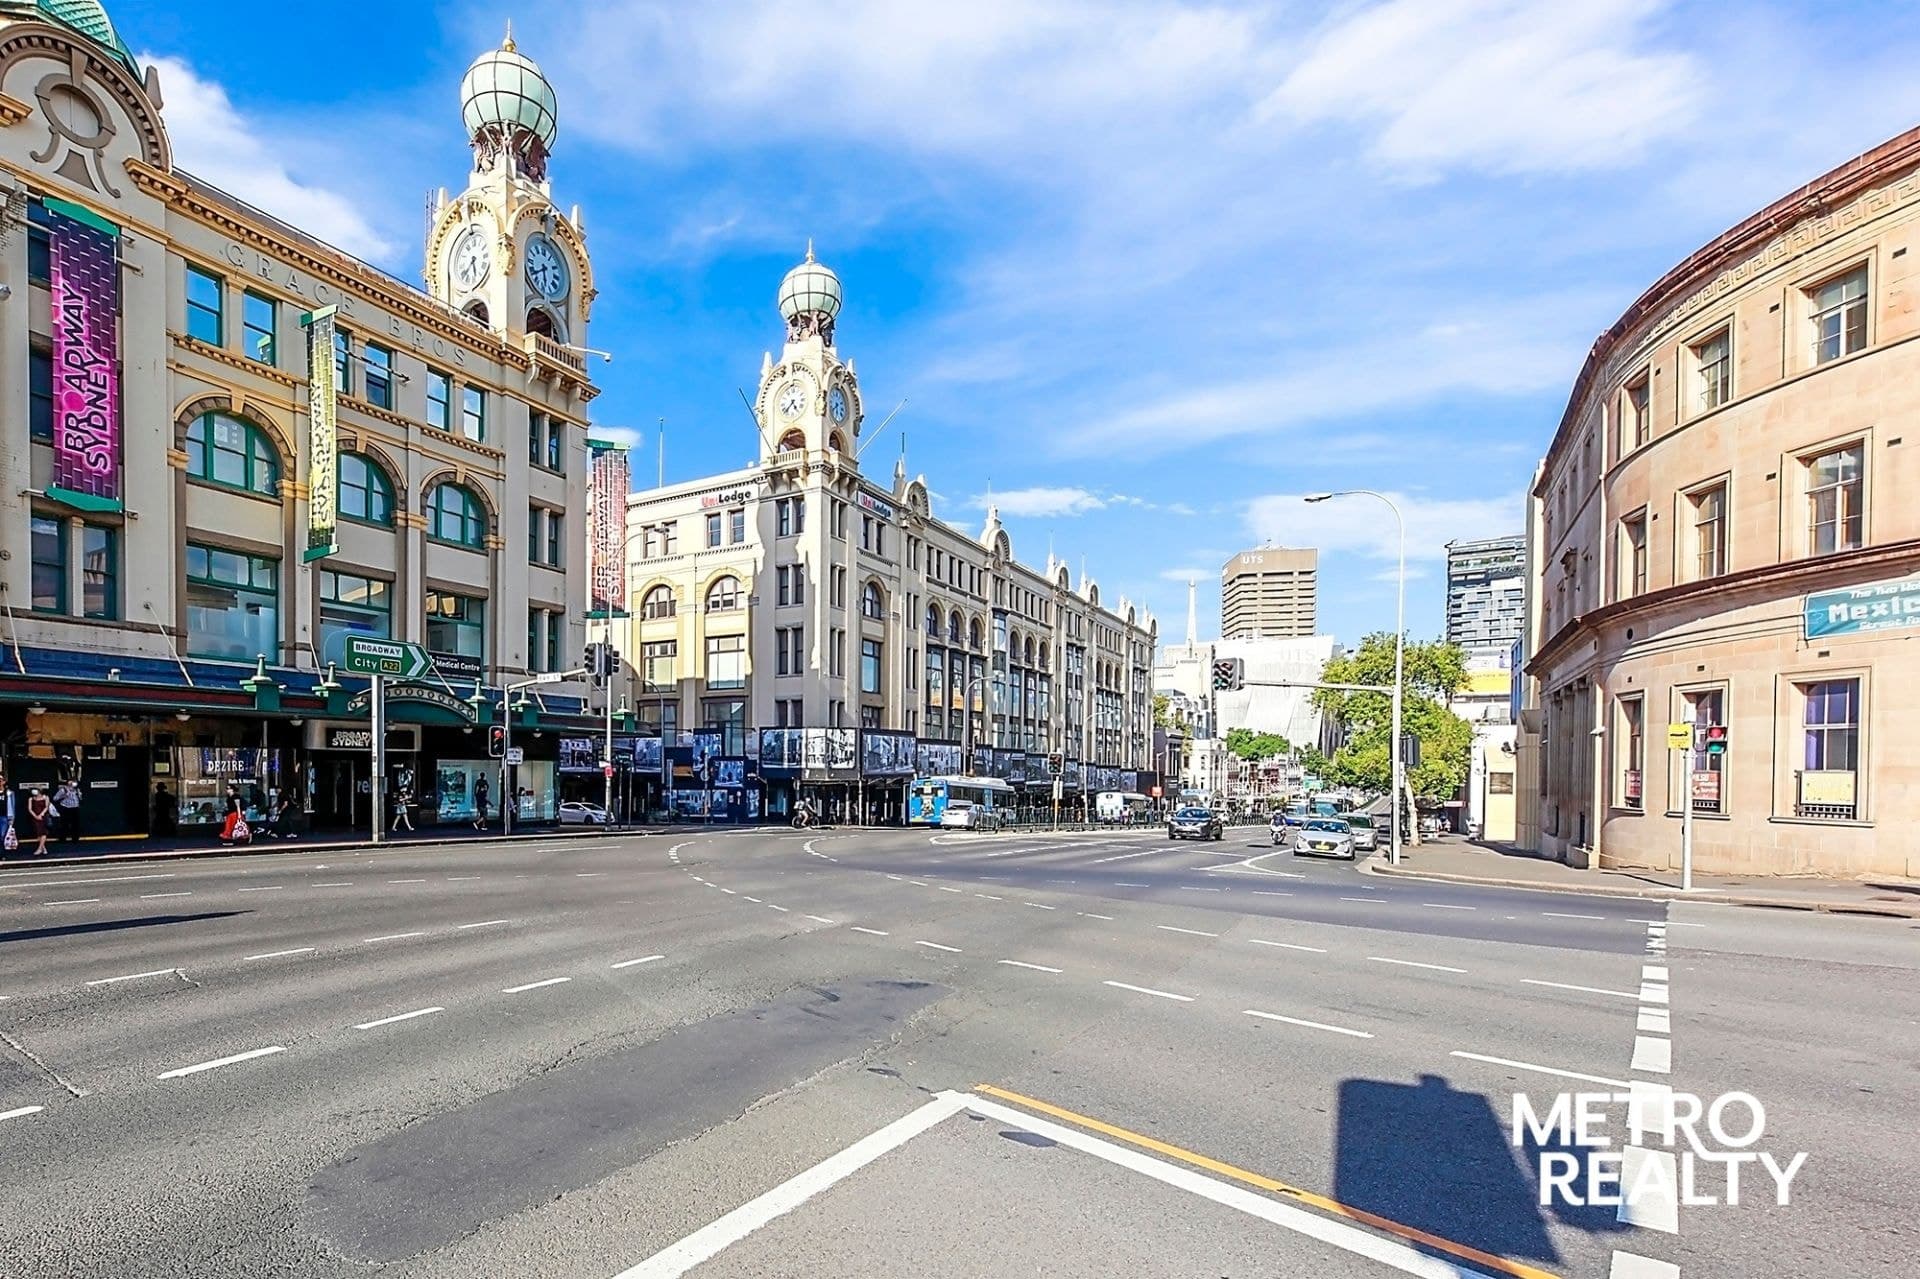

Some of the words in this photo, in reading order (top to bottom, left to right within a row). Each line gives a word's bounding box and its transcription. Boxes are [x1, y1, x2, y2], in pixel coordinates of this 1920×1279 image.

[226, 242, 355, 318] GRACE
[387, 314, 465, 367] BROS
[83, 347, 109, 472] SYDNEY
[1243, 555, 1264, 565] UTS
[355, 643, 401, 655] BROADWAY
[354, 657, 377, 670] City
[383, 662, 399, 671] A22
[436, 660, 460, 670] Medical
[460, 662, 481, 672] Centre
[332, 738, 371, 748] SYDNEY
[208, 760, 245, 773] DEZIRE
